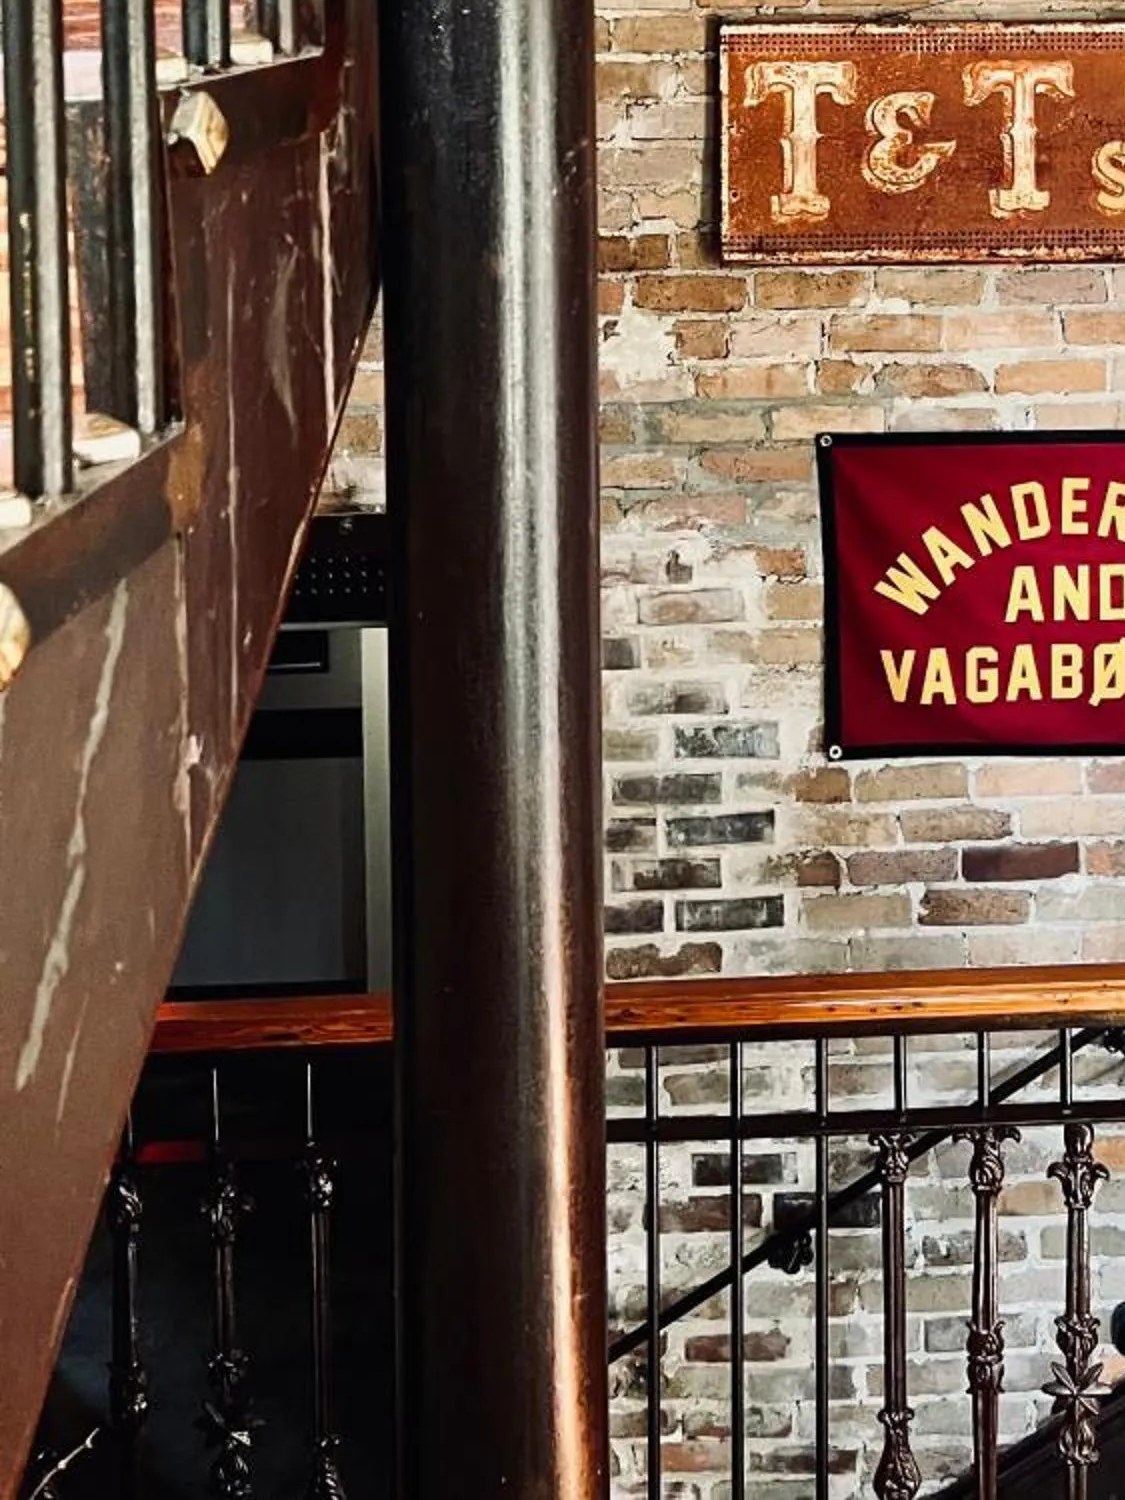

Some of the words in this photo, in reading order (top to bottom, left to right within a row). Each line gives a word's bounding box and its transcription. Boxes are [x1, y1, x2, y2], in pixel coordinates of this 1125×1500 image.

[744, 60, 857, 223] T
[861, 90, 956, 194] &
[962, 58, 1075, 220] T
